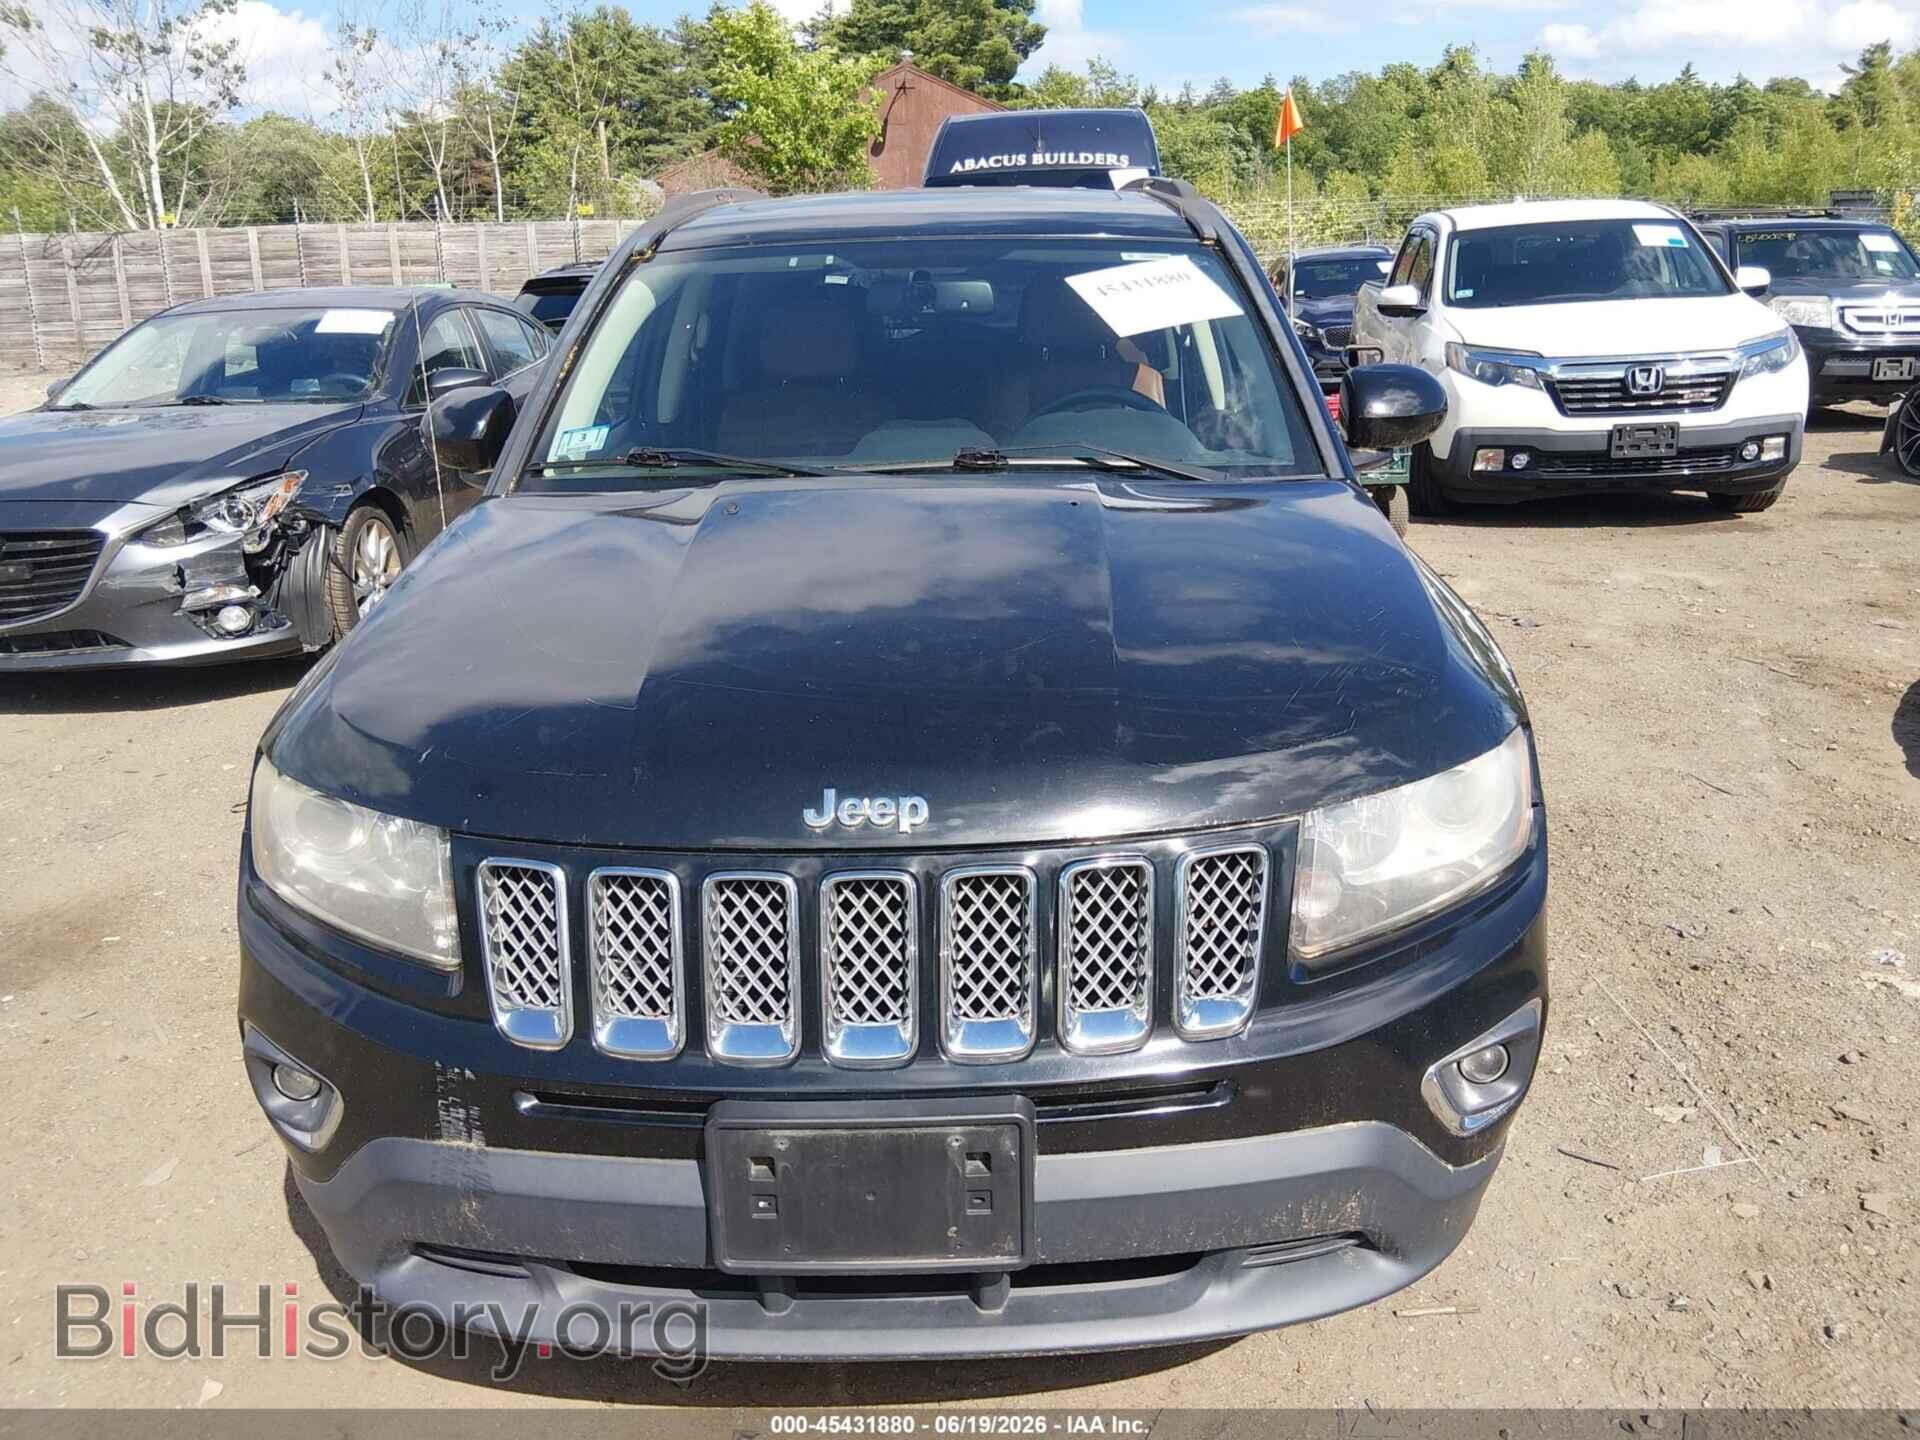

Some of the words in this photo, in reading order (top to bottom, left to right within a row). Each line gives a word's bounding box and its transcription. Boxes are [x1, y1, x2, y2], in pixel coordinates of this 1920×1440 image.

[951, 154, 1026, 174] ABACUS
[1032, 151, 1129, 168] BUILDERS
[803, 788, 929, 834] Jeep
